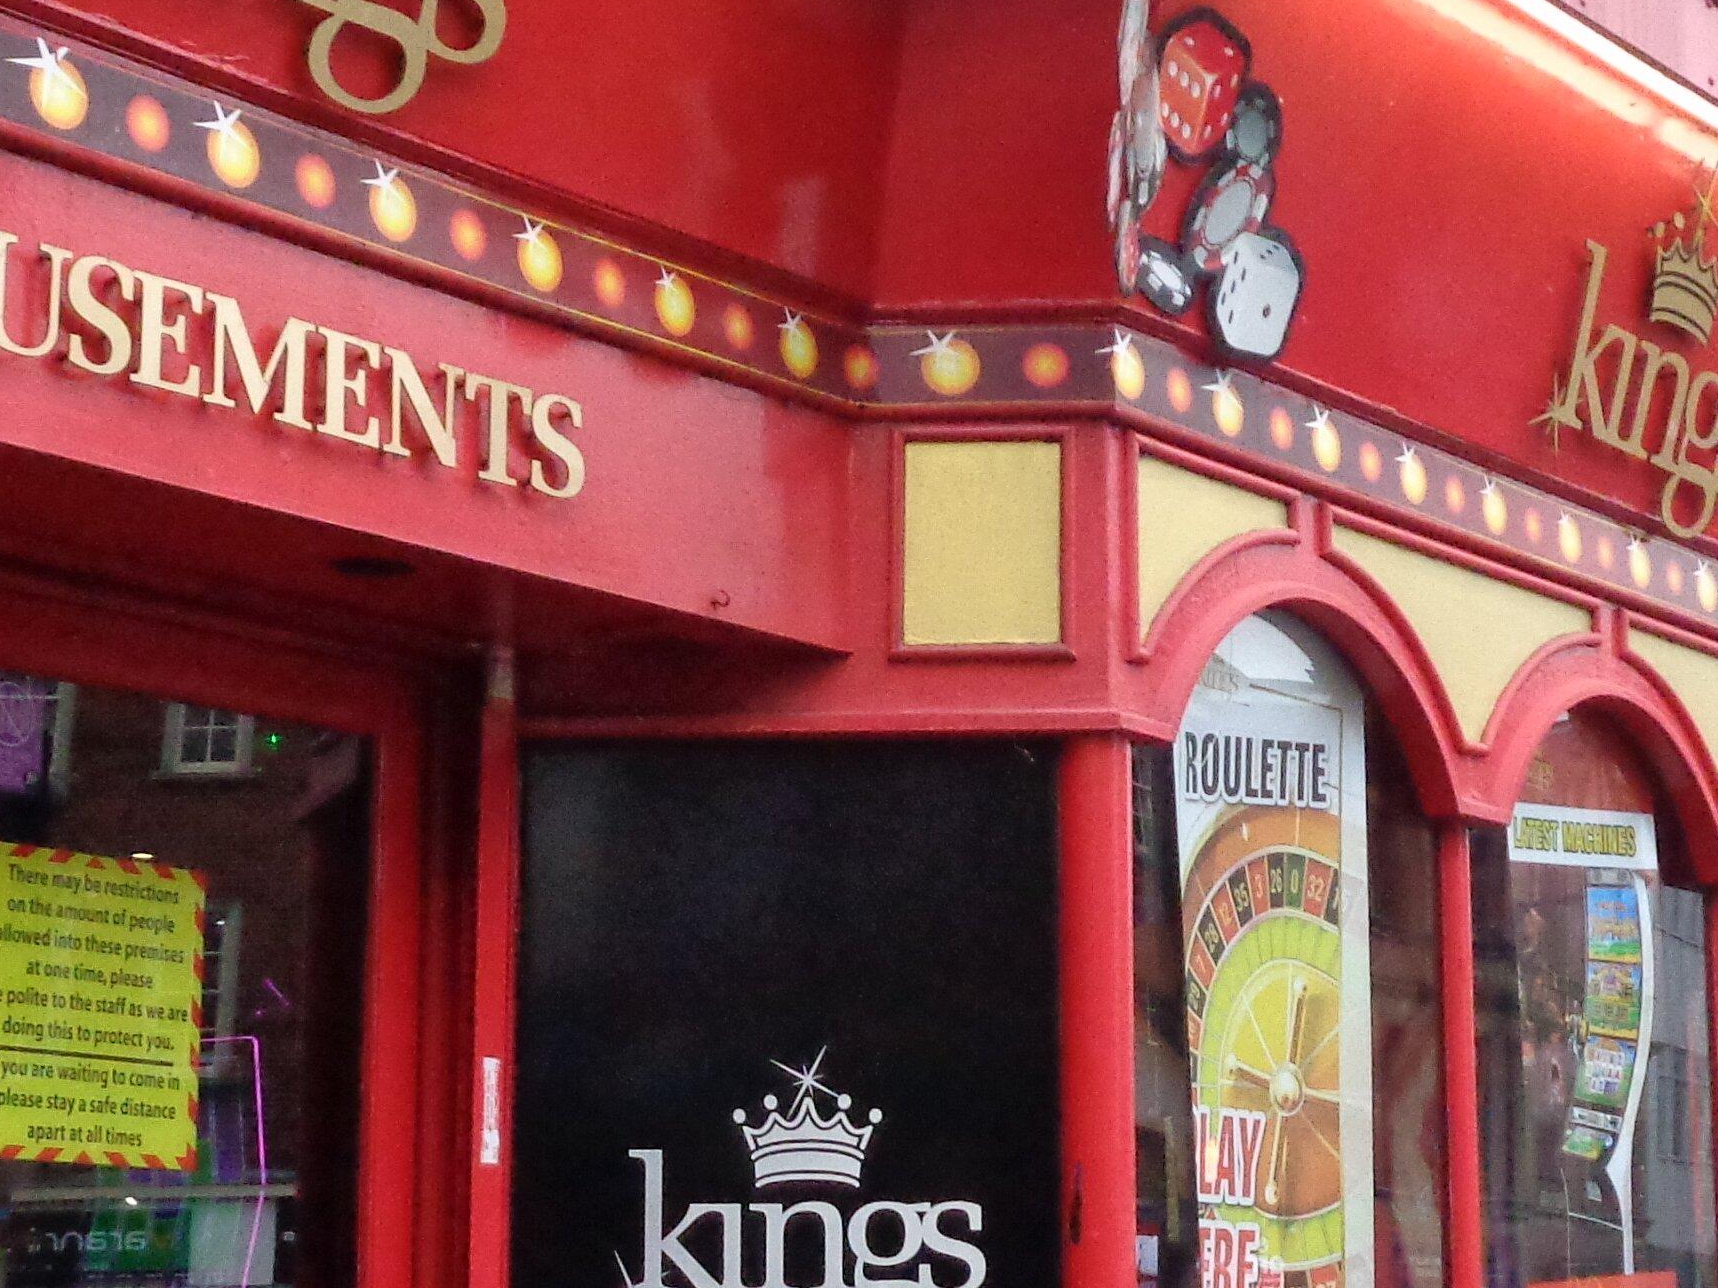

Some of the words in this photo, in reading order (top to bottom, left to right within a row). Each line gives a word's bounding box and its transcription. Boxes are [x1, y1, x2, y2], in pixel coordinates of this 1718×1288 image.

[1183, 730, 1328, 804] ROULETTE
[1561, 820, 1637, 858] MACHINES
[8, 863, 49, 886] There
[52, 873, 82, 895] may
[84, 873, 102, 893] be
[104, 881, 179, 905] restrictions
[6, 897, 26, 913] on
[29, 897, 52, 918] the
[55, 904, 110, 924] amount
[112, 908, 127, 926] of
[129, 914, 175, 936] people
[54, 930, 82, 951] into
[85, 934, 122, 956] these
[124, 943, 185, 964] premises
[25, 960, 41, 976] at
[43, 964, 70, 979] one
[110, 969, 154, 989] please
[6, 987, 48, 1008] polite
[52, 991, 67, 1009] to
[69, 993, 92, 1012] the
[95, 996, 127, 1016] staff
[129, 1002, 143, 1018] as
[145, 1005, 165, 1020] we
[167, 1007, 188, 1022] are
[1, 1014, 44, 1042] doing
[47, 1019, 73, 1041] this
[77, 1024, 91, 1042] to
[94, 1028, 144, 1048] protect
[0, 1061, 29, 1080] you
[31, 1063, 54, 1078] are
[57, 1063, 109, 1089] waiting
[112, 1068, 127, 1085] to
[129, 1073, 165, 1089] come
[167, 1072, 180, 1091] in
[46, 1093, 76, 1117] stay
[89, 1095, 116, 1114] safe
[119, 1097, 177, 1120] distance
[26, 1124, 66, 1144] apart
[69, 1126, 83, 1143] at
[86, 1124, 103, 1143] all
[105, 1126, 142, 1147] times
[1196, 1109, 1263, 1202] LAY
